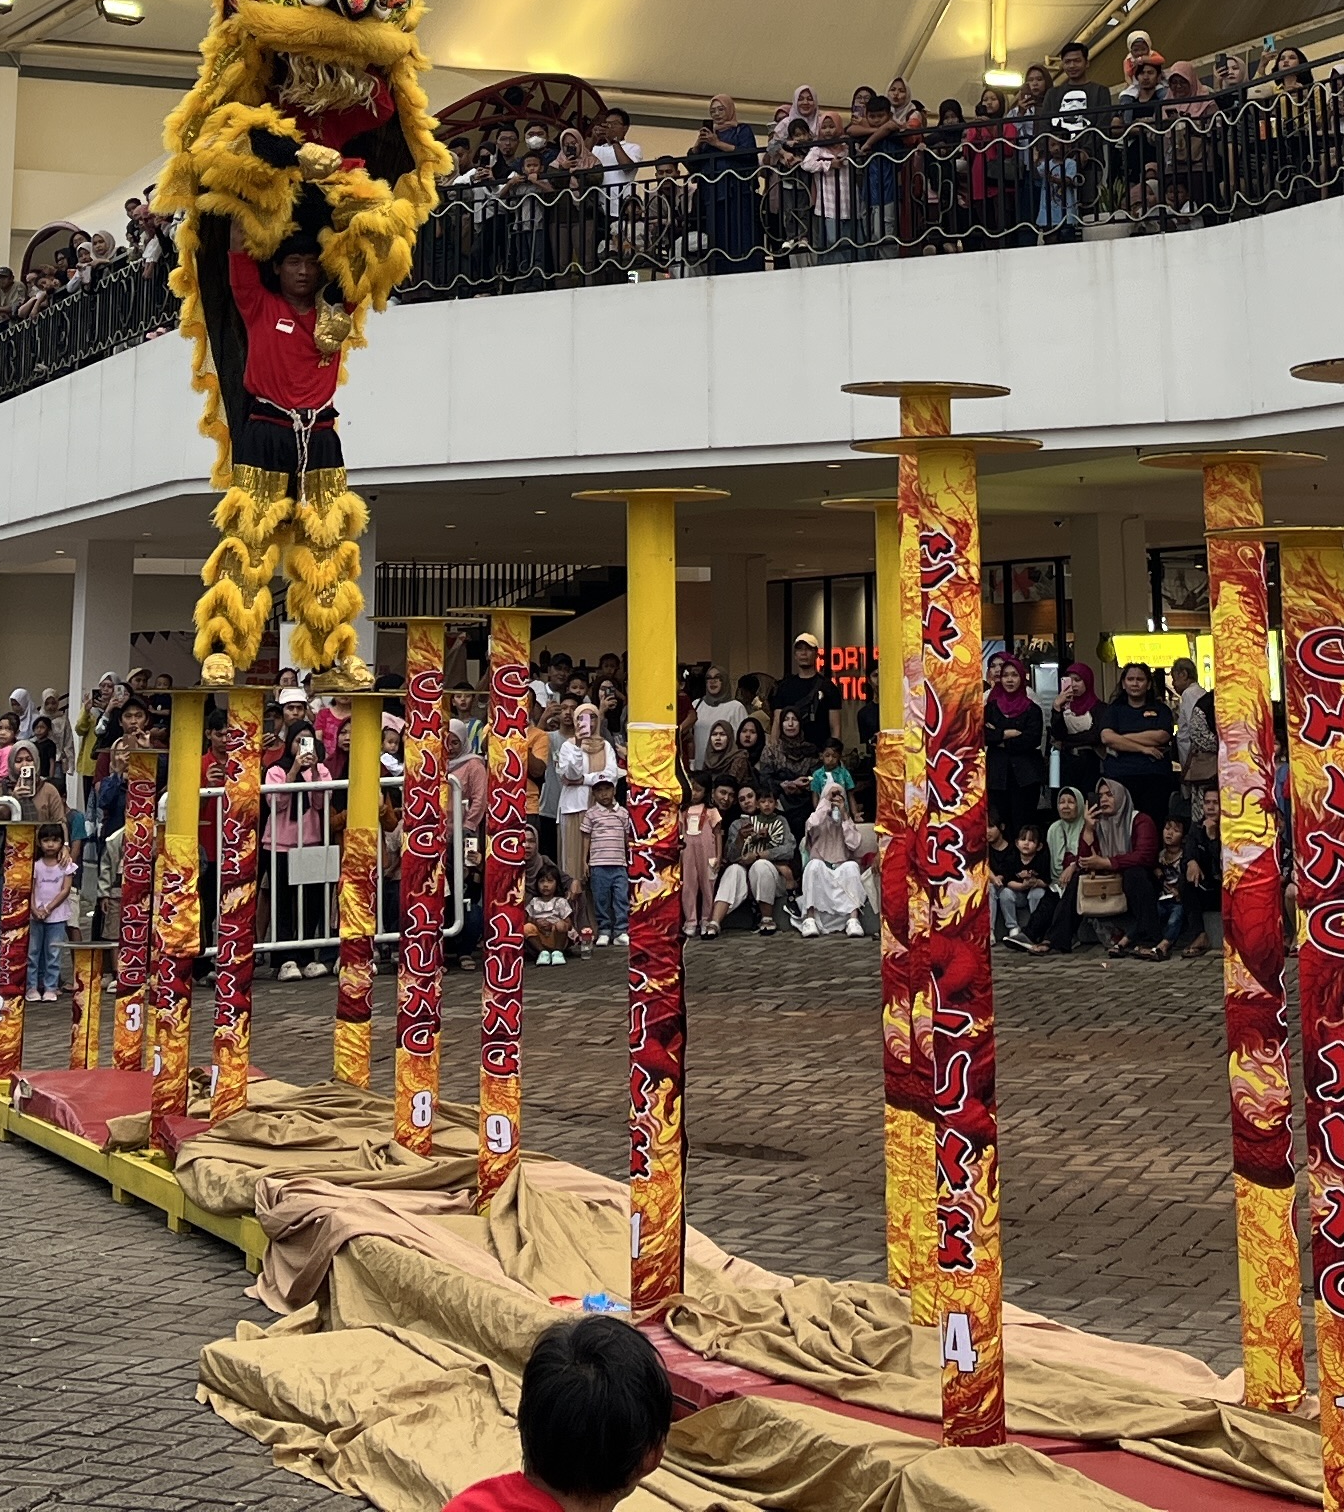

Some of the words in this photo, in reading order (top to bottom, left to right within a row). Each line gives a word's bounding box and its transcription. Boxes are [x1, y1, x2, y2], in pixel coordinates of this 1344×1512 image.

[400, 669, 444, 861] CHING
[486, 663, 530, 866] CHING
[123, 780, 155, 884] CHING
[118, 903, 150, 987] LUNG
[400, 901, 443, 1057] LUNG
[481, 913, 525, 1079] LUNG
[125, 1003, 141, 1033] 3
[411, 1090, 432, 1128] 8
[485, 1114, 512, 1154] 9
